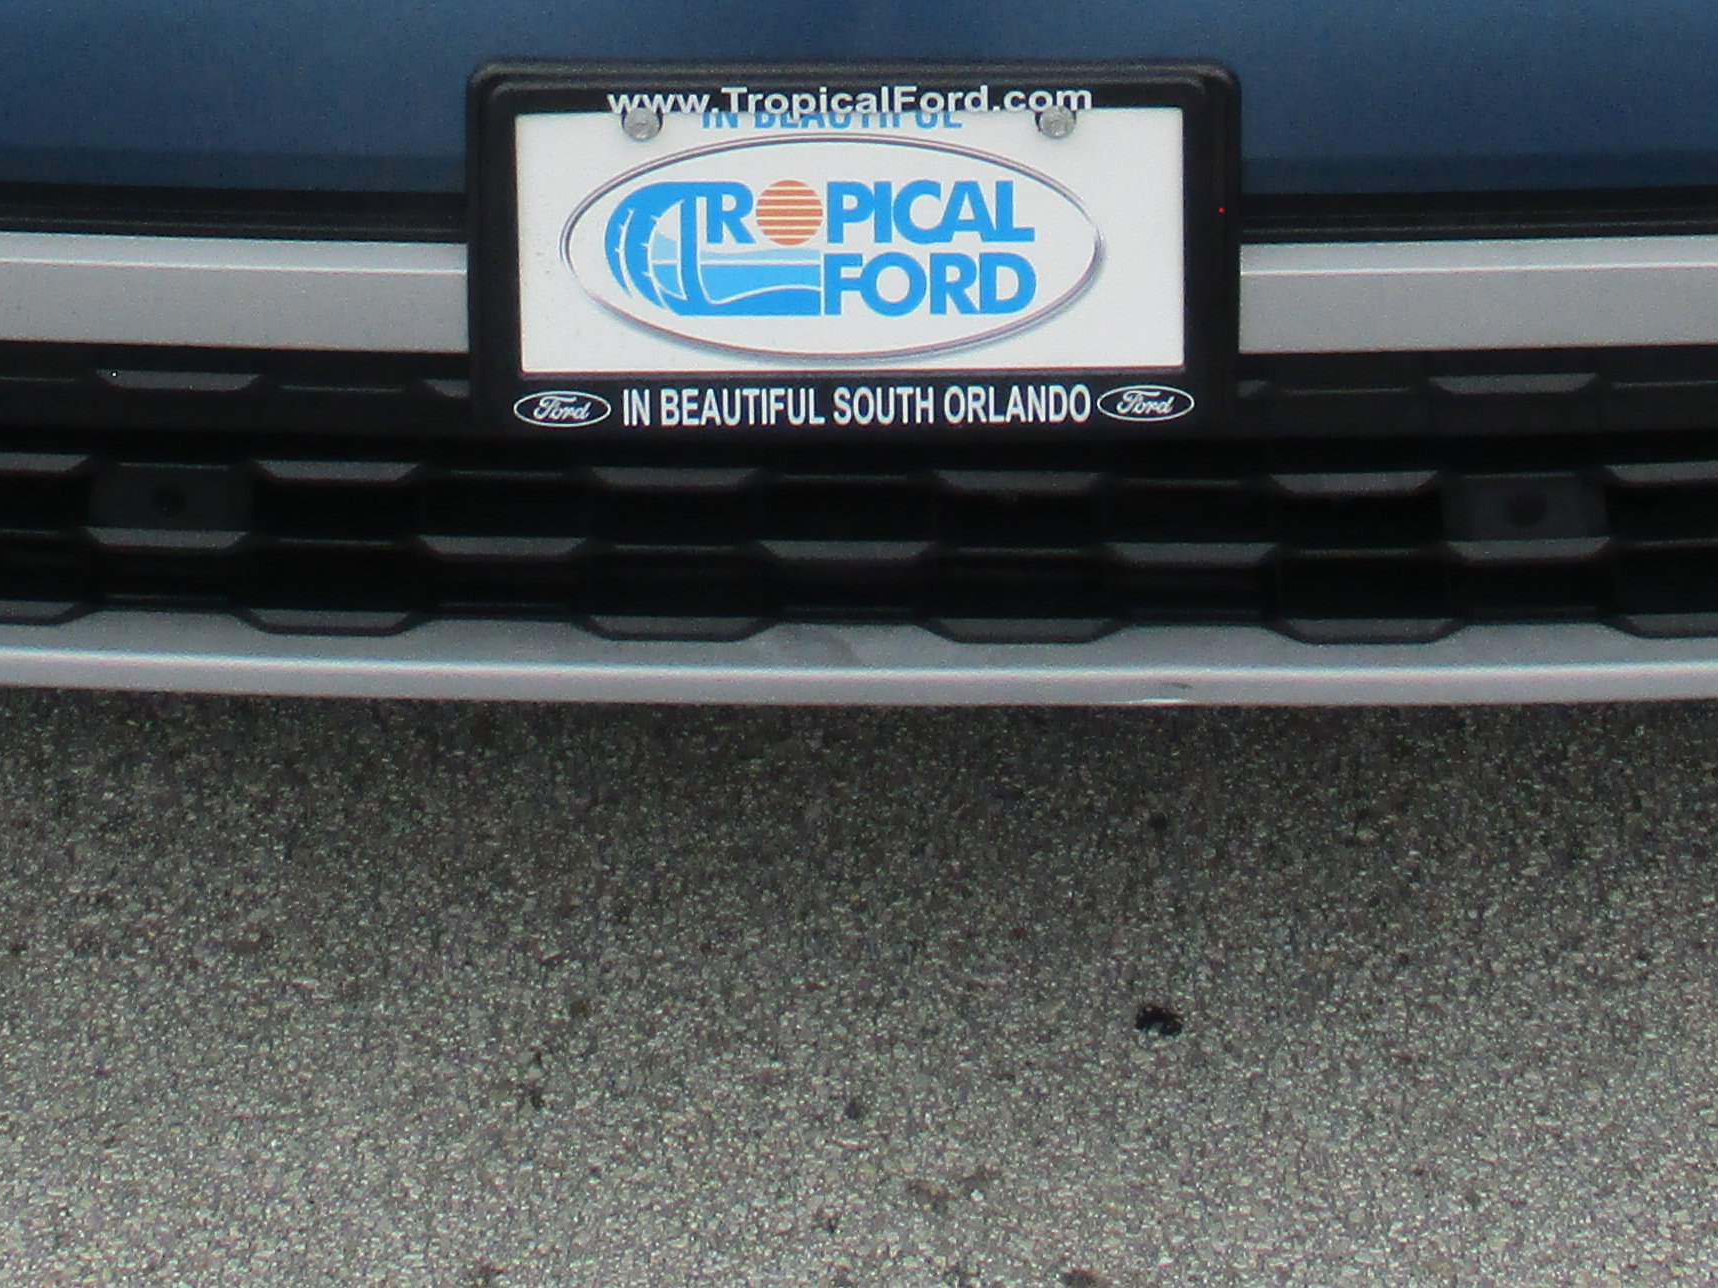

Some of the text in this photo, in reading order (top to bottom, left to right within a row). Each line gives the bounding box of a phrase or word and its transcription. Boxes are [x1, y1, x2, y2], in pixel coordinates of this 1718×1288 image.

[607, 85, 1093, 120] www.TropicalFord.com
[605, 180, 1035, 246] TROPICAL
[824, 251, 1038, 317] FORD
[533, 394, 591, 421] Ford
[622, 384, 1091, 426] IN BEAUTIFUL SOUTH ORLANDO
[1116, 390, 1174, 416] Ford
